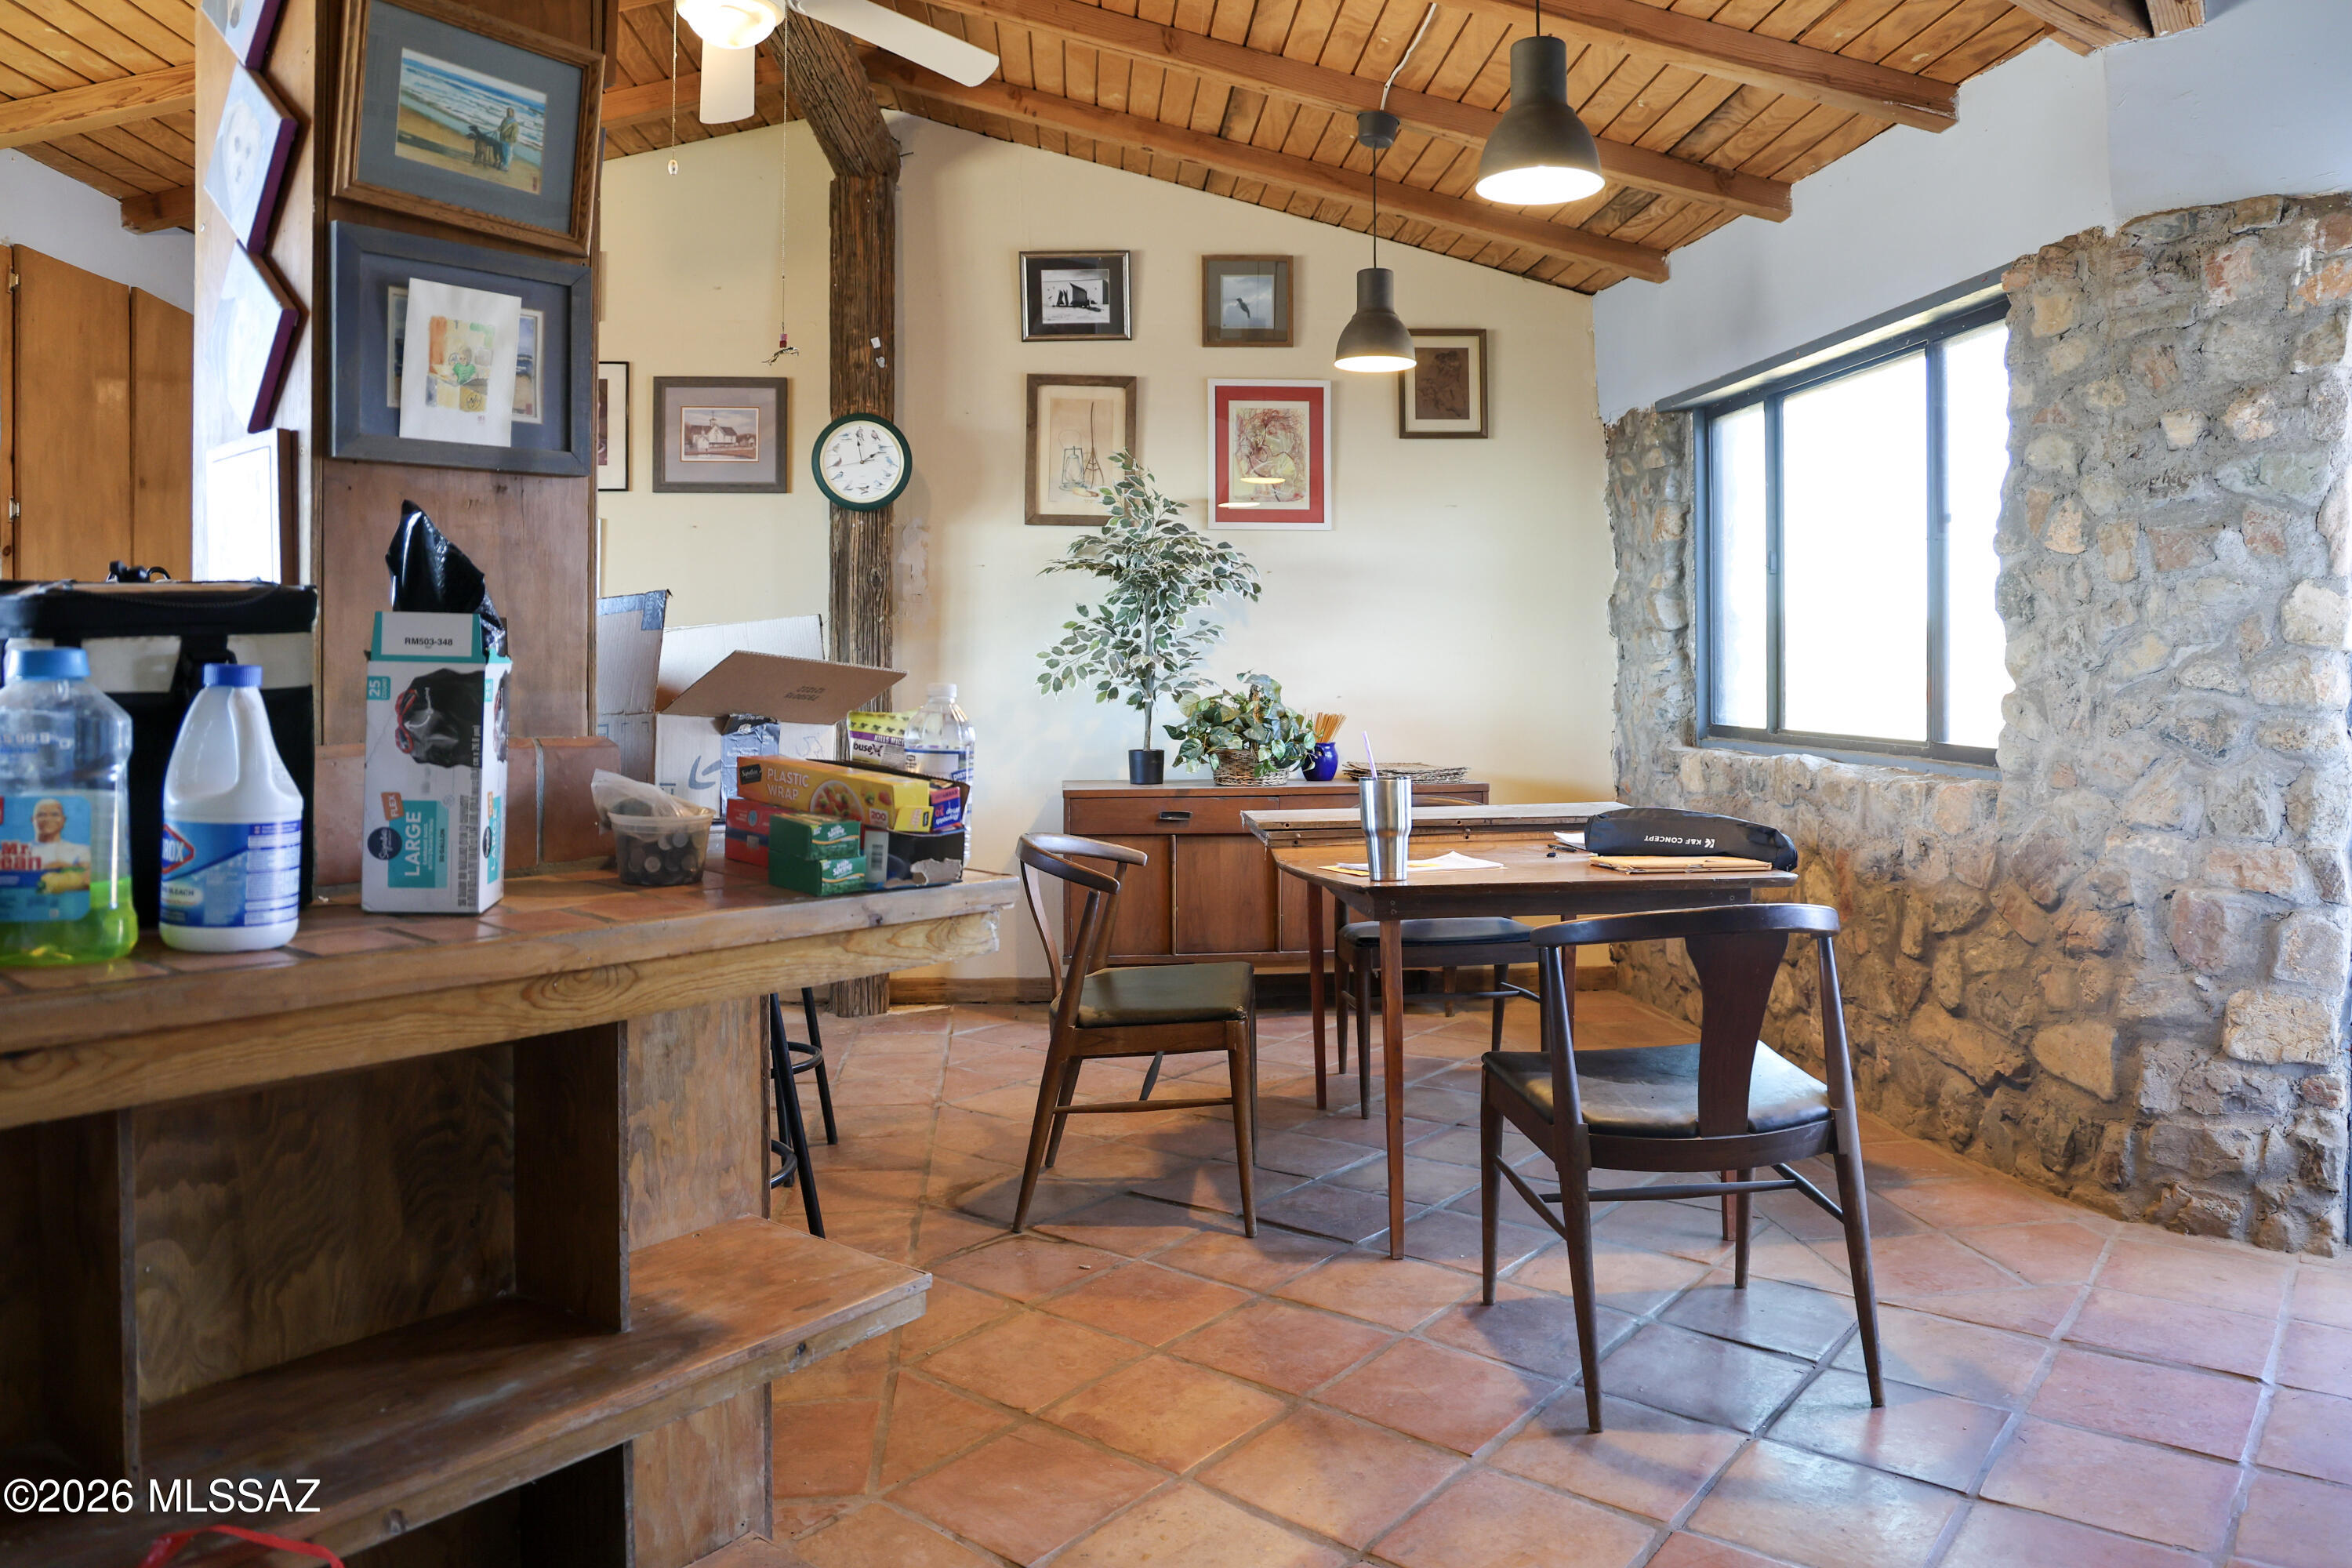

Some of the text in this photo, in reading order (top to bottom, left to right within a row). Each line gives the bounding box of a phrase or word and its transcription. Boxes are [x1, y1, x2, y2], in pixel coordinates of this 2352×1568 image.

[404, 637, 454, 647] RM503-348
[368, 680, 381, 697] 25
[874, 734, 890, 744] KILLS
[767, 768, 810, 788] PLASTIC
[767, 784, 799, 800] WRAP
[387, 794, 399, 818] FLEX
[871, 811, 886, 822] 200
[404, 811, 422, 877] LARGE
[1643, 835, 1684, 844] CONCEPT
[1685, 837, 1703, 846] K&F
[162, 838, 183, 862] ROX
